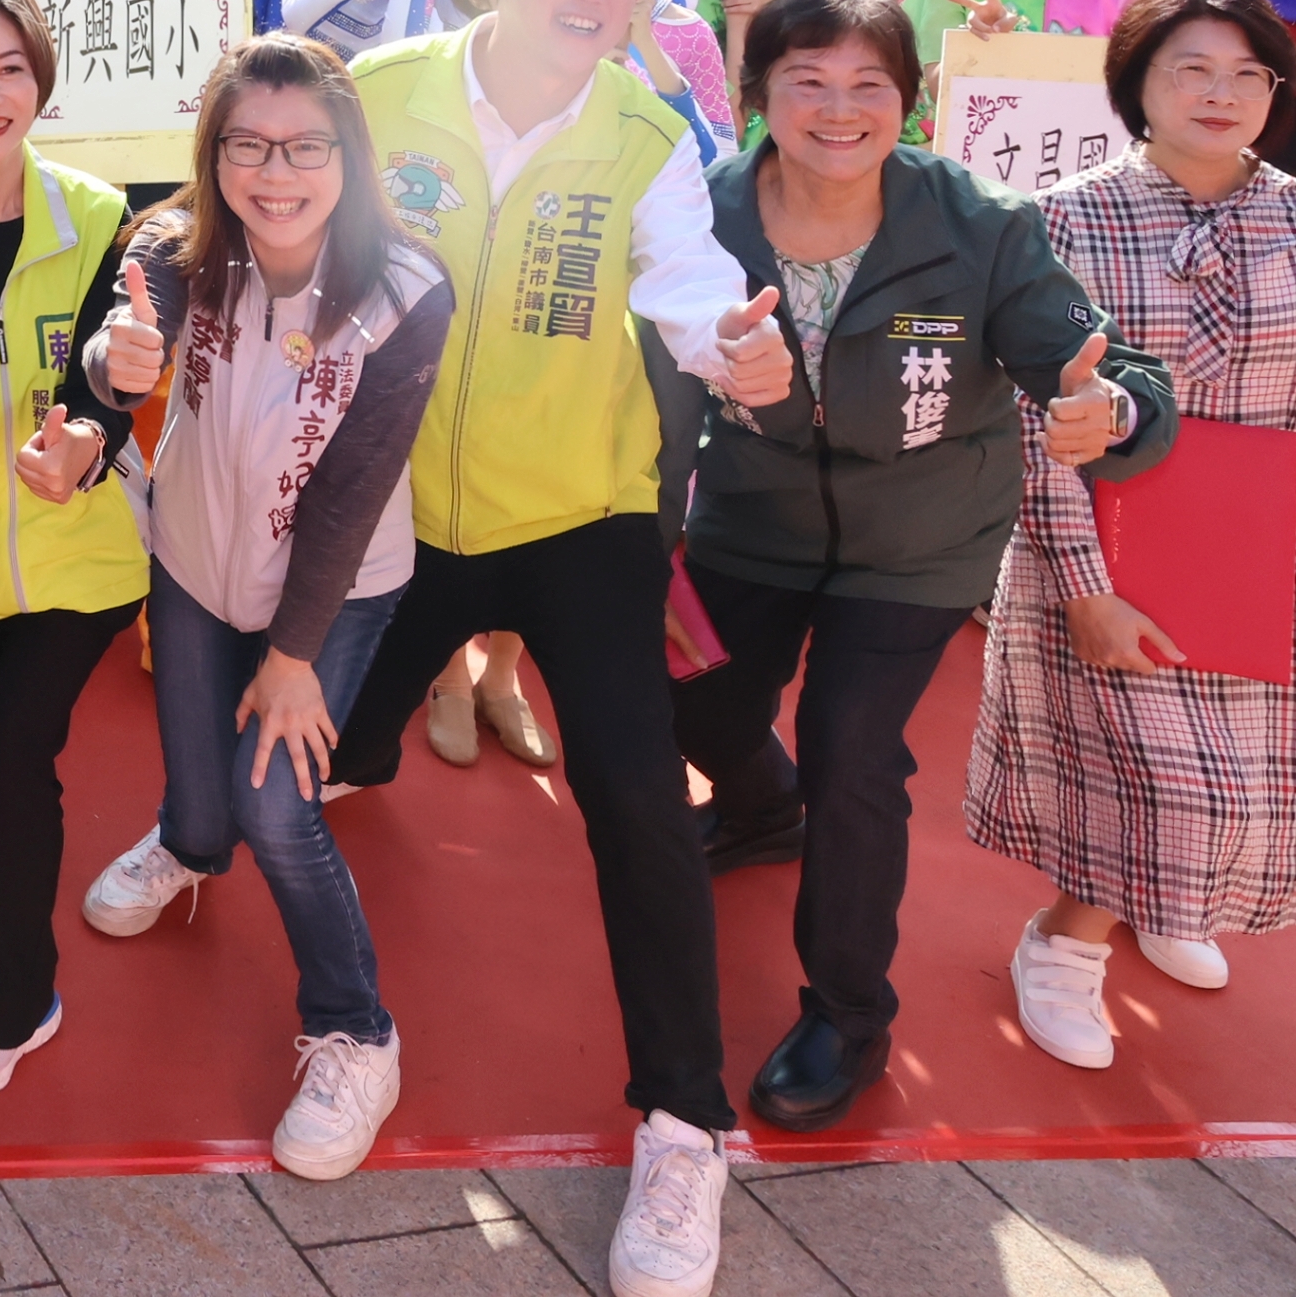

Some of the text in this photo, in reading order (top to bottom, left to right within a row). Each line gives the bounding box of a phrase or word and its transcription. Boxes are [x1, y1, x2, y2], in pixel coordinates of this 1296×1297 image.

[521, 222, 556, 335] 台南市議員
[543, 193, 612, 341] 王宣貿
[912, 321, 959, 335] DPP
